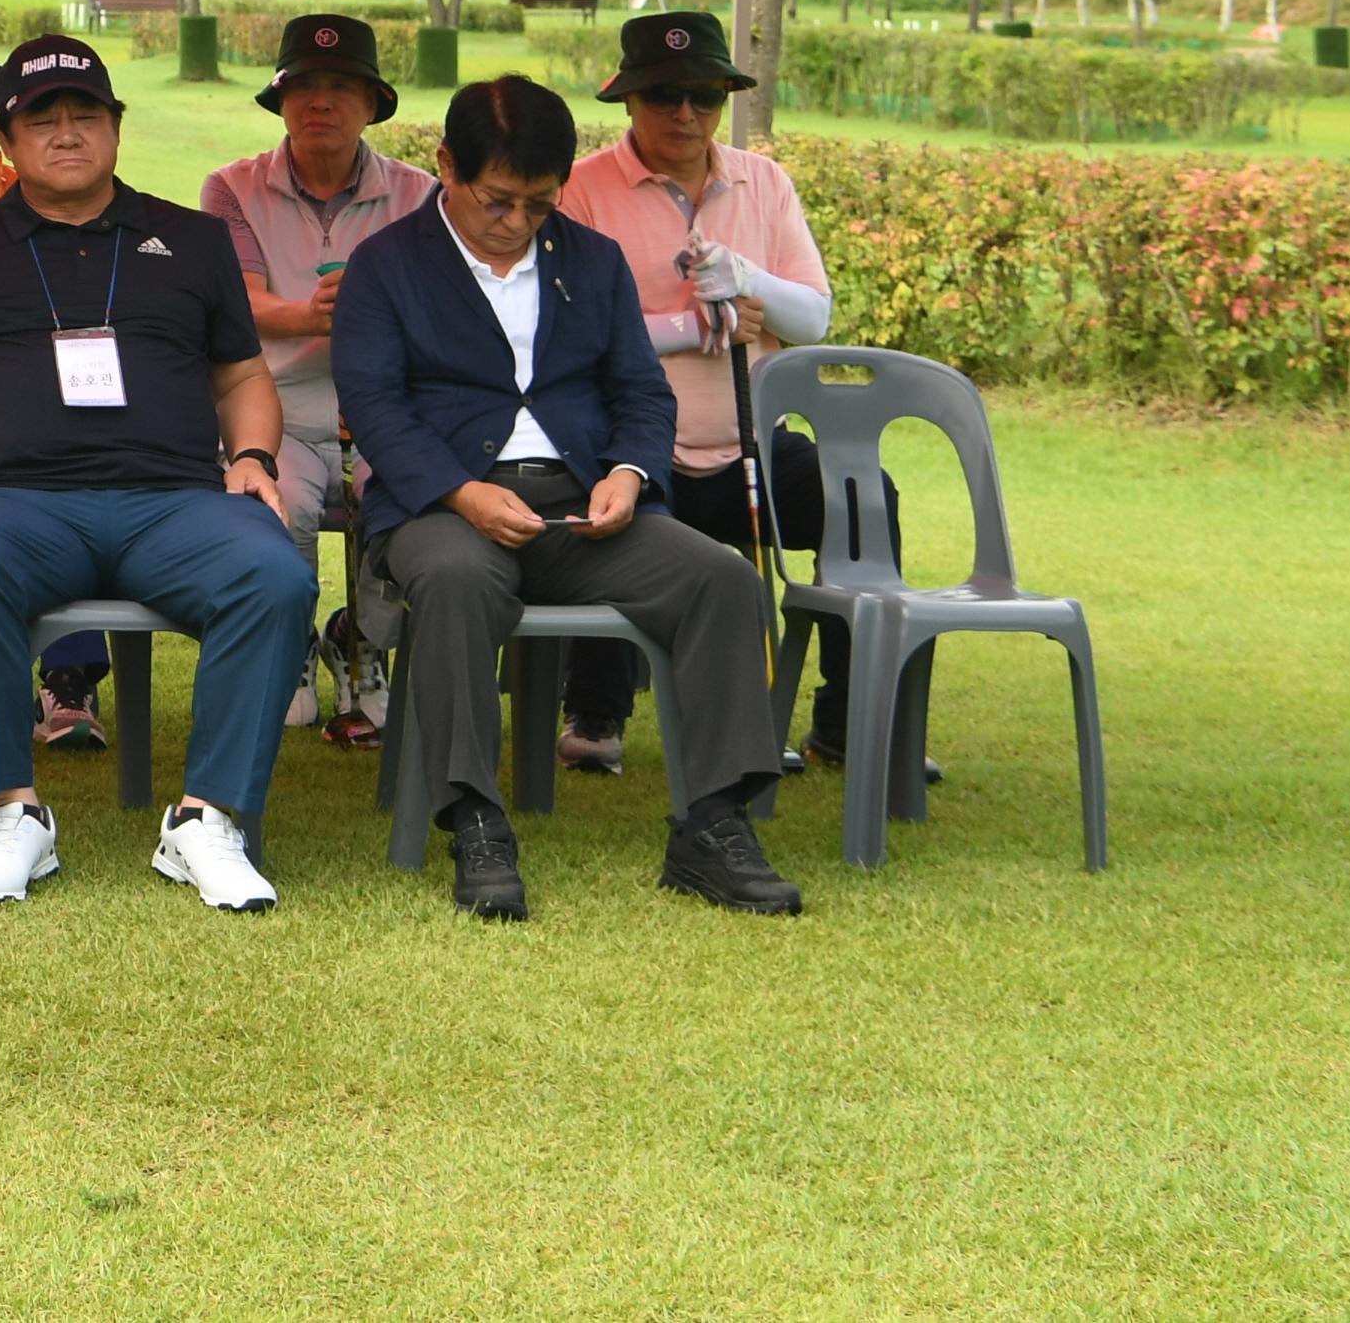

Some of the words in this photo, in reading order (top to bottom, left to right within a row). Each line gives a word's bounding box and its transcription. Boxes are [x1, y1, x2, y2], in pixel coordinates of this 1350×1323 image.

[21, 54, 57, 77] AHWA
[58, 53, 92, 71] GOLF
[137, 246, 173, 257] adidas
